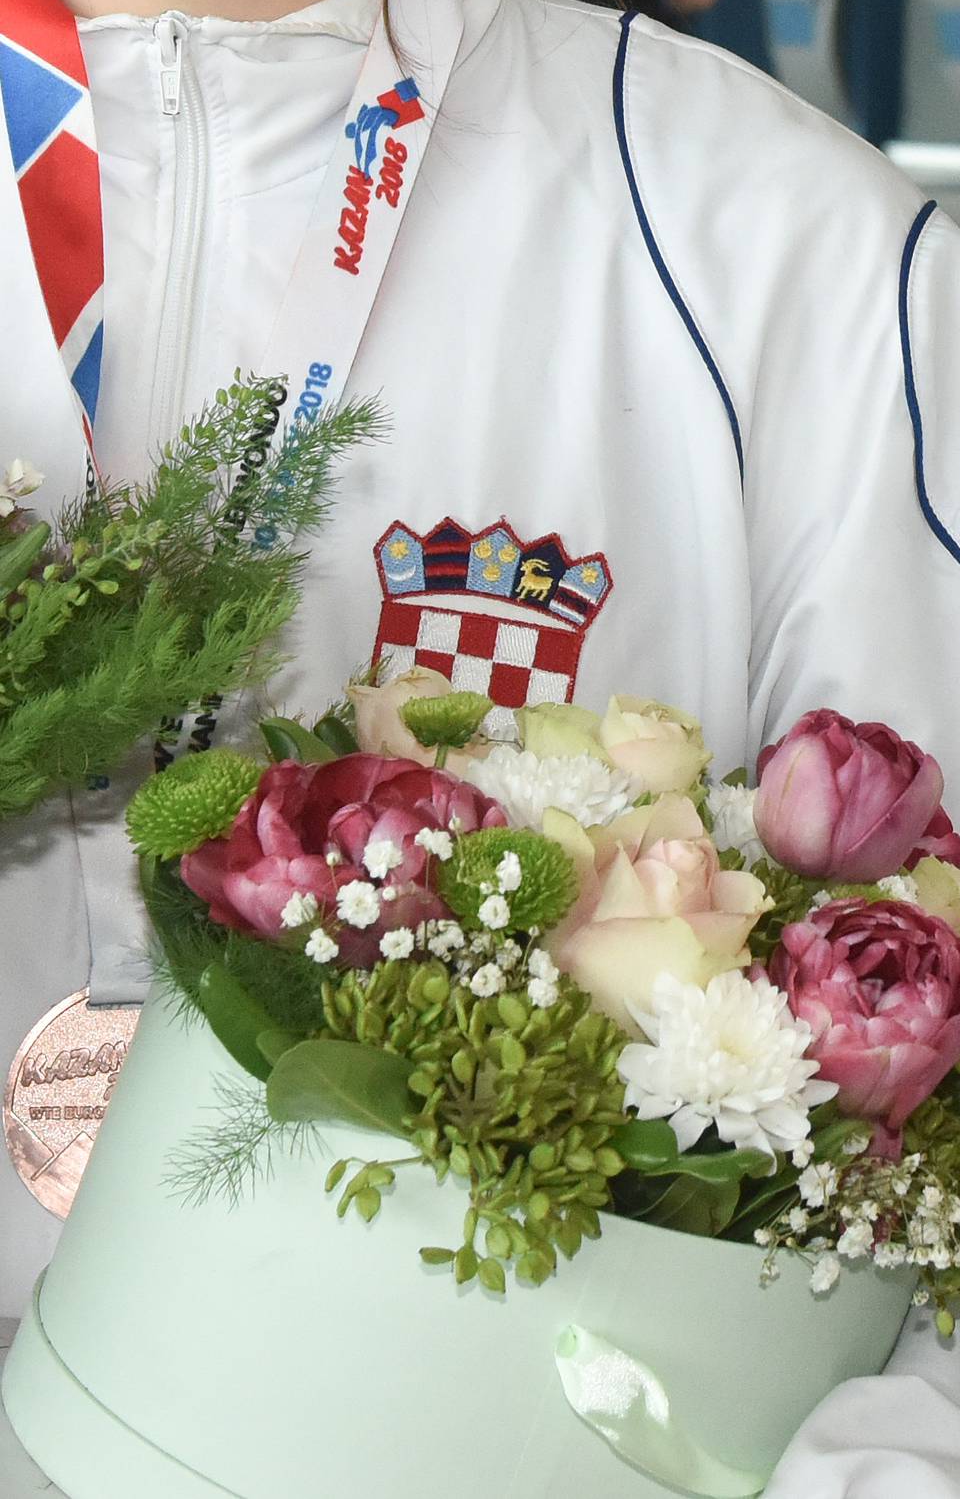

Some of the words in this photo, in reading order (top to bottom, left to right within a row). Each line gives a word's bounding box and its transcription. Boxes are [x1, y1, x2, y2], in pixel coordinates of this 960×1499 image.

[375, 136, 408, 208] 2018
[334, 164, 373, 276] KAZAN
[294, 361, 332, 423] 2018
